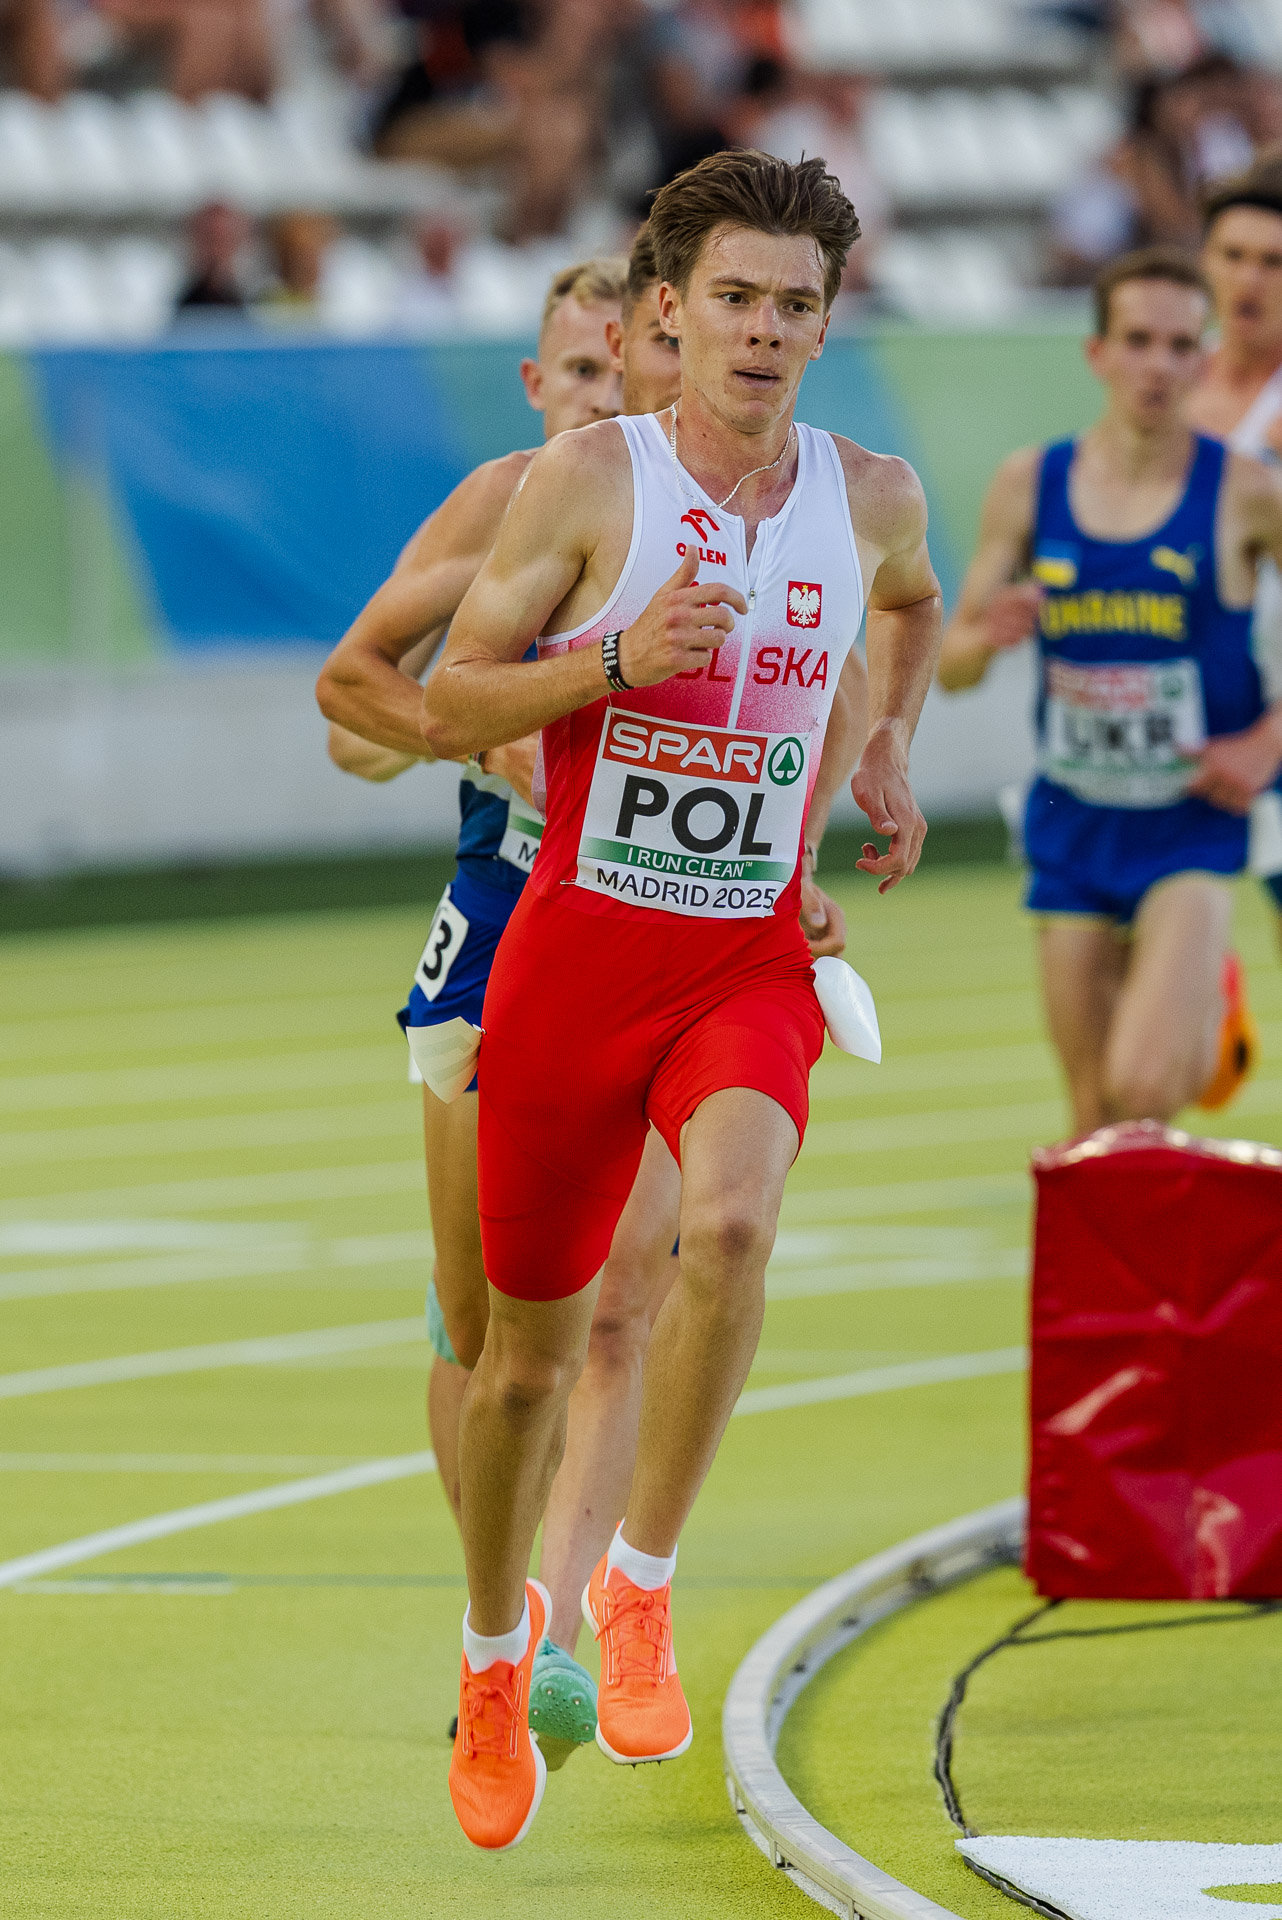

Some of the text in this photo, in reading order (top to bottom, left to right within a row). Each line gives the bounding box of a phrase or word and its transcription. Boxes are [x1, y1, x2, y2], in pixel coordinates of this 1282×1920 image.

[676, 542, 727, 566] OLEN
[675, 646, 828, 691] LSKA
[609, 721, 761, 777] SPAR
[615, 774, 773, 856] POL
[626, 847, 634, 863] I
[636, 849, 682, 872] RUN
[596, 867, 777, 910] MADRID 2025
[422, 919, 453, 981] 3
